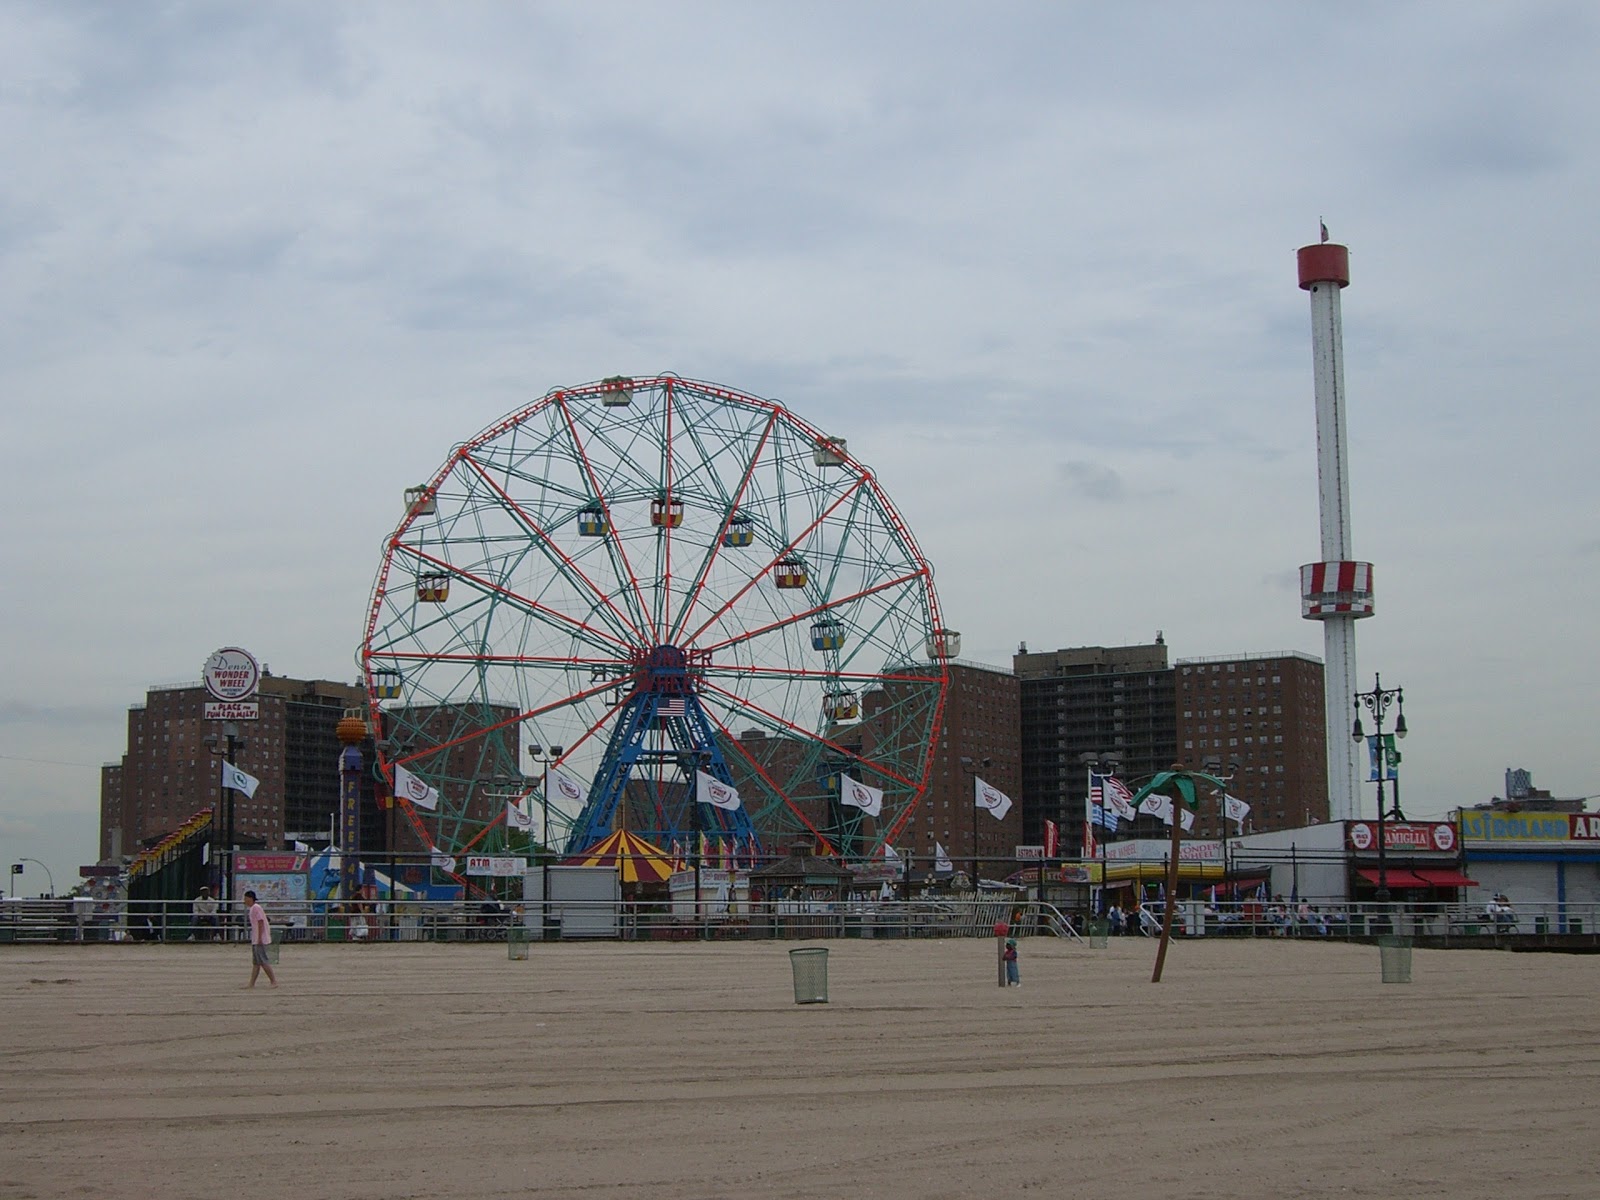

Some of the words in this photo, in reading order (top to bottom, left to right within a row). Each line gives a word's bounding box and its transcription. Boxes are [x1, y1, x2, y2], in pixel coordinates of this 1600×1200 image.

[210, 655, 252, 670] Deno's
[634, 648, 713, 668] WONDER
[214, 670, 250, 679] WONDER
[219, 679, 246, 688] WHEEL
[217, 703, 241, 711] PLACE
[1463, 812, 1569, 840] ASTROLAND
[1383, 832, 1427, 844] AMIGLIA
[470, 858, 490, 867] ATM
